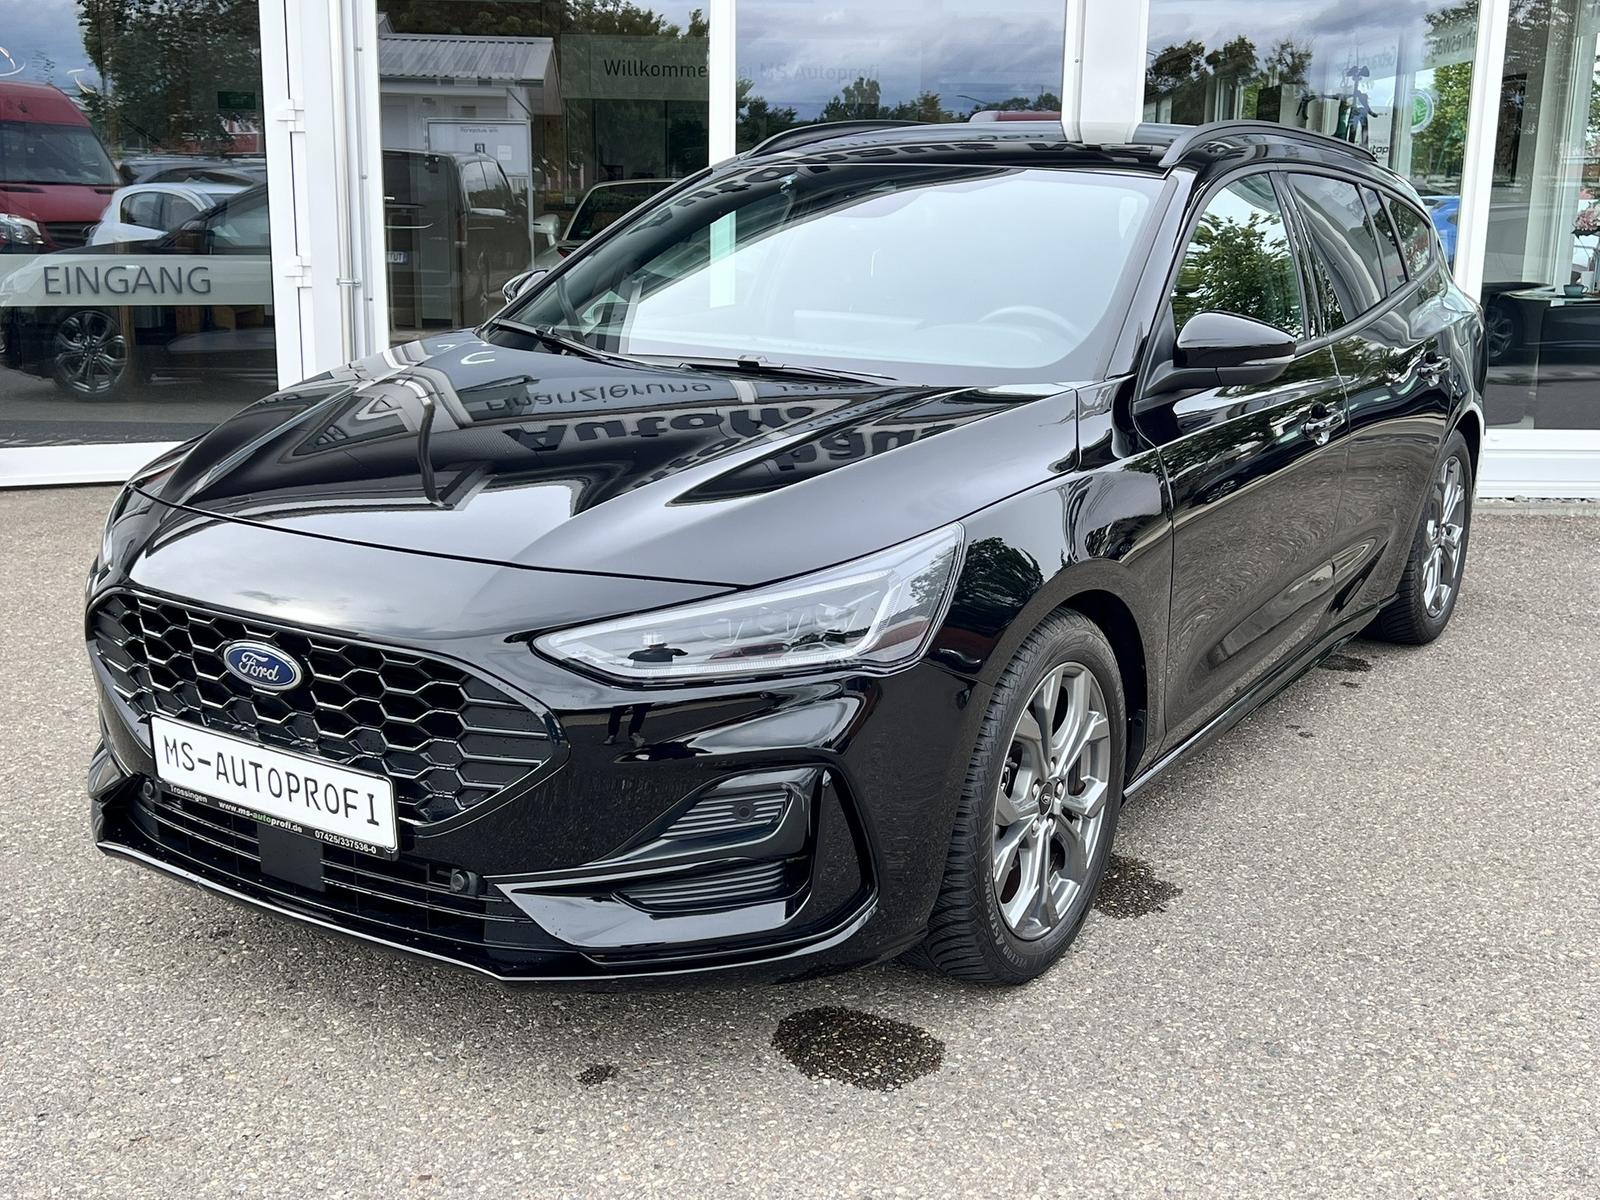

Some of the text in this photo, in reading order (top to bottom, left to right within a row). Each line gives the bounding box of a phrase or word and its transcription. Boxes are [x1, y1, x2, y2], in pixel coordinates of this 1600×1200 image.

[604, 58, 708, 78] Willkomme
[43, 266, 212, 295] EINGANG
[238, 651, 280, 681] Ford
[163, 735, 380, 827] MS-AUTOPROFI
[218, 800, 303, 834] www.ms-autoprofi.de
